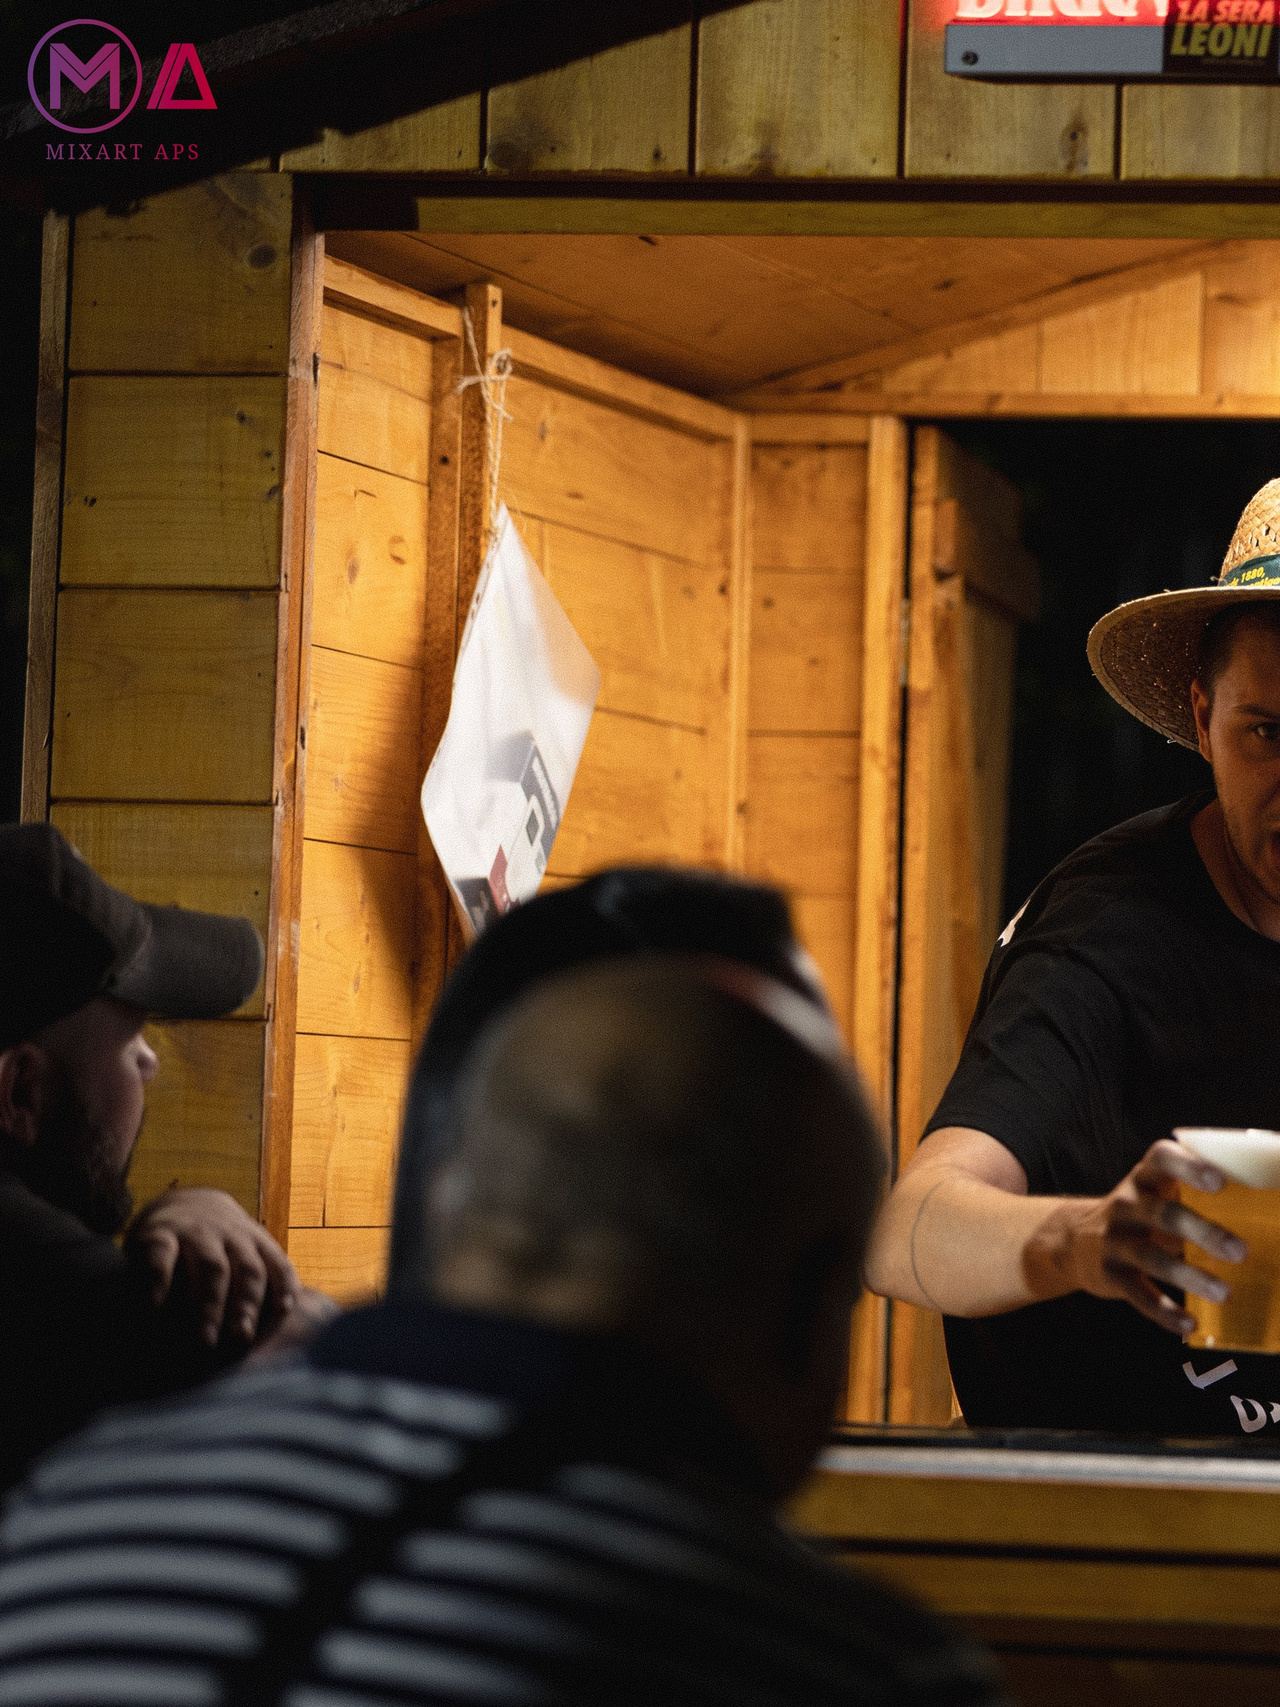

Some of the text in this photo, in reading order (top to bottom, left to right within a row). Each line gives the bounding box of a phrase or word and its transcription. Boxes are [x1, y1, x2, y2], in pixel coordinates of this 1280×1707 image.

[1212, 0, 1275, 22] SERA
[1169, 22, 1274, 58] LEONI
[1240, 566, 1266, 583] 1880,
